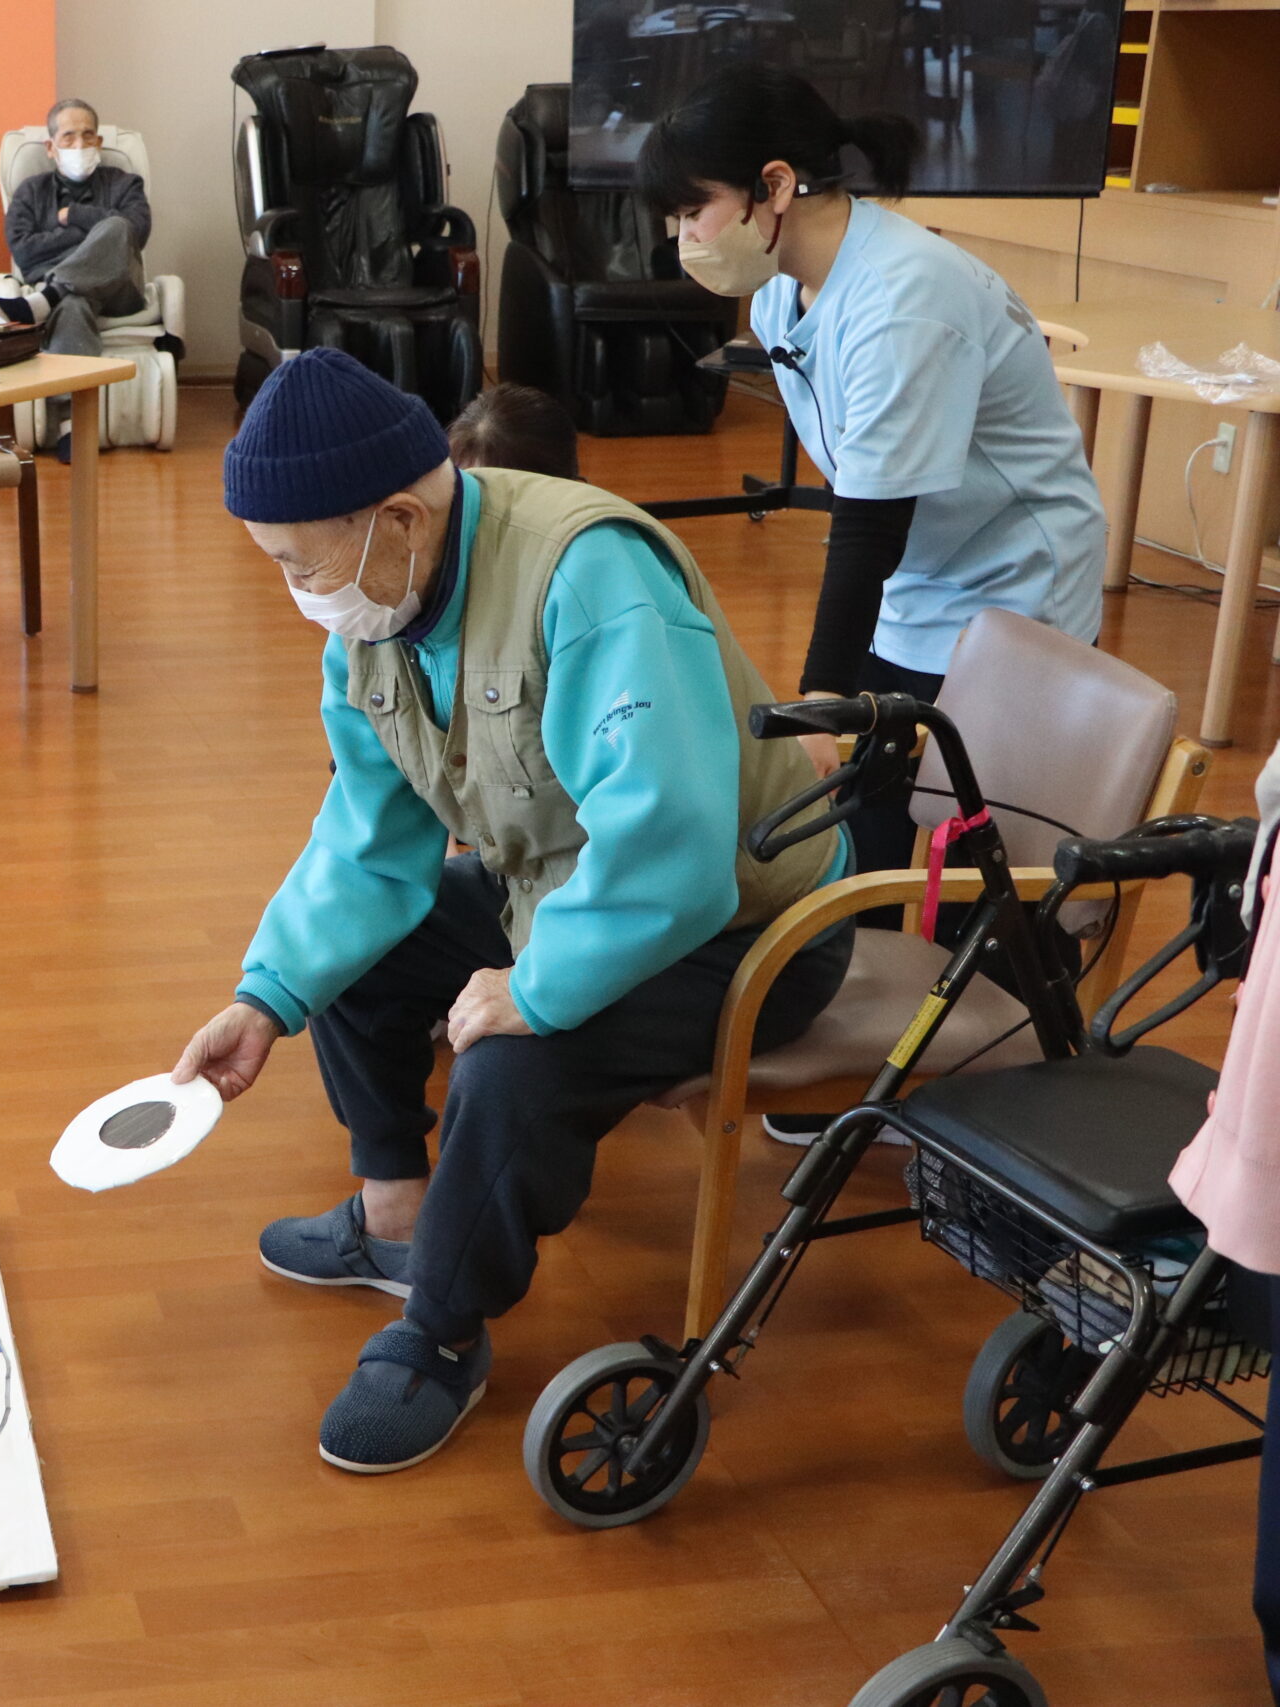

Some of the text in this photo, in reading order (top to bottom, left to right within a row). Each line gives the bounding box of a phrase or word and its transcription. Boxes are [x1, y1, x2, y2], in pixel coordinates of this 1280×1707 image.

[606, 701, 651, 722] Brings Joy
[621, 711, 634, 721] All
